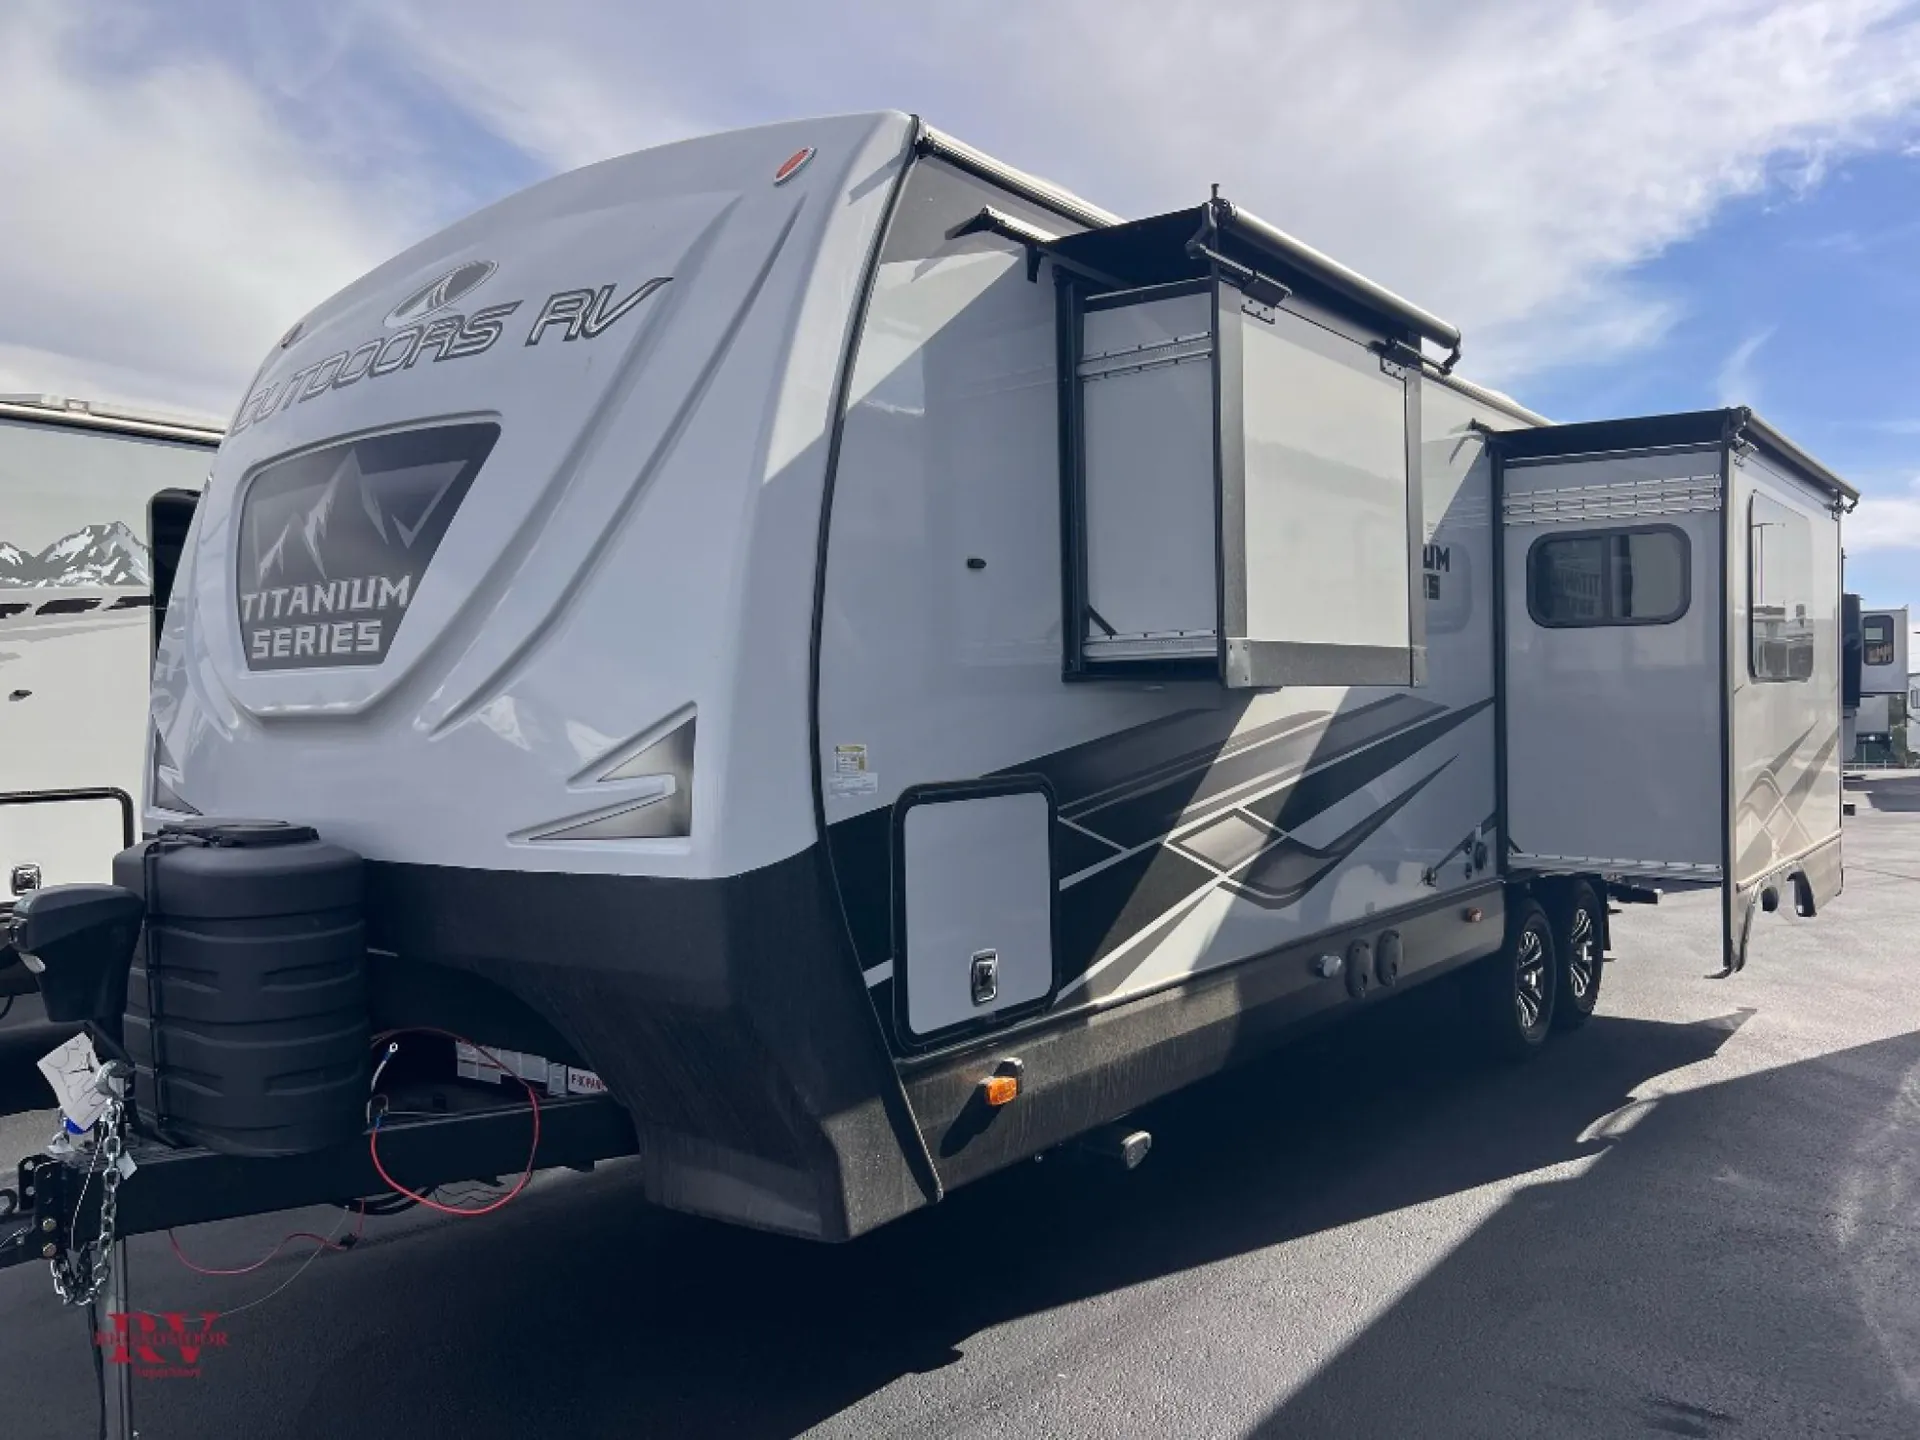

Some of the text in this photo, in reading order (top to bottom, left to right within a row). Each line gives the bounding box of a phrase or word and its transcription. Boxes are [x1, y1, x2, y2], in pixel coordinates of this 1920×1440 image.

[525, 277, 674, 347] RV
[241, 574, 412, 622] TITANIUM
[251, 619, 383, 660] SERIES
